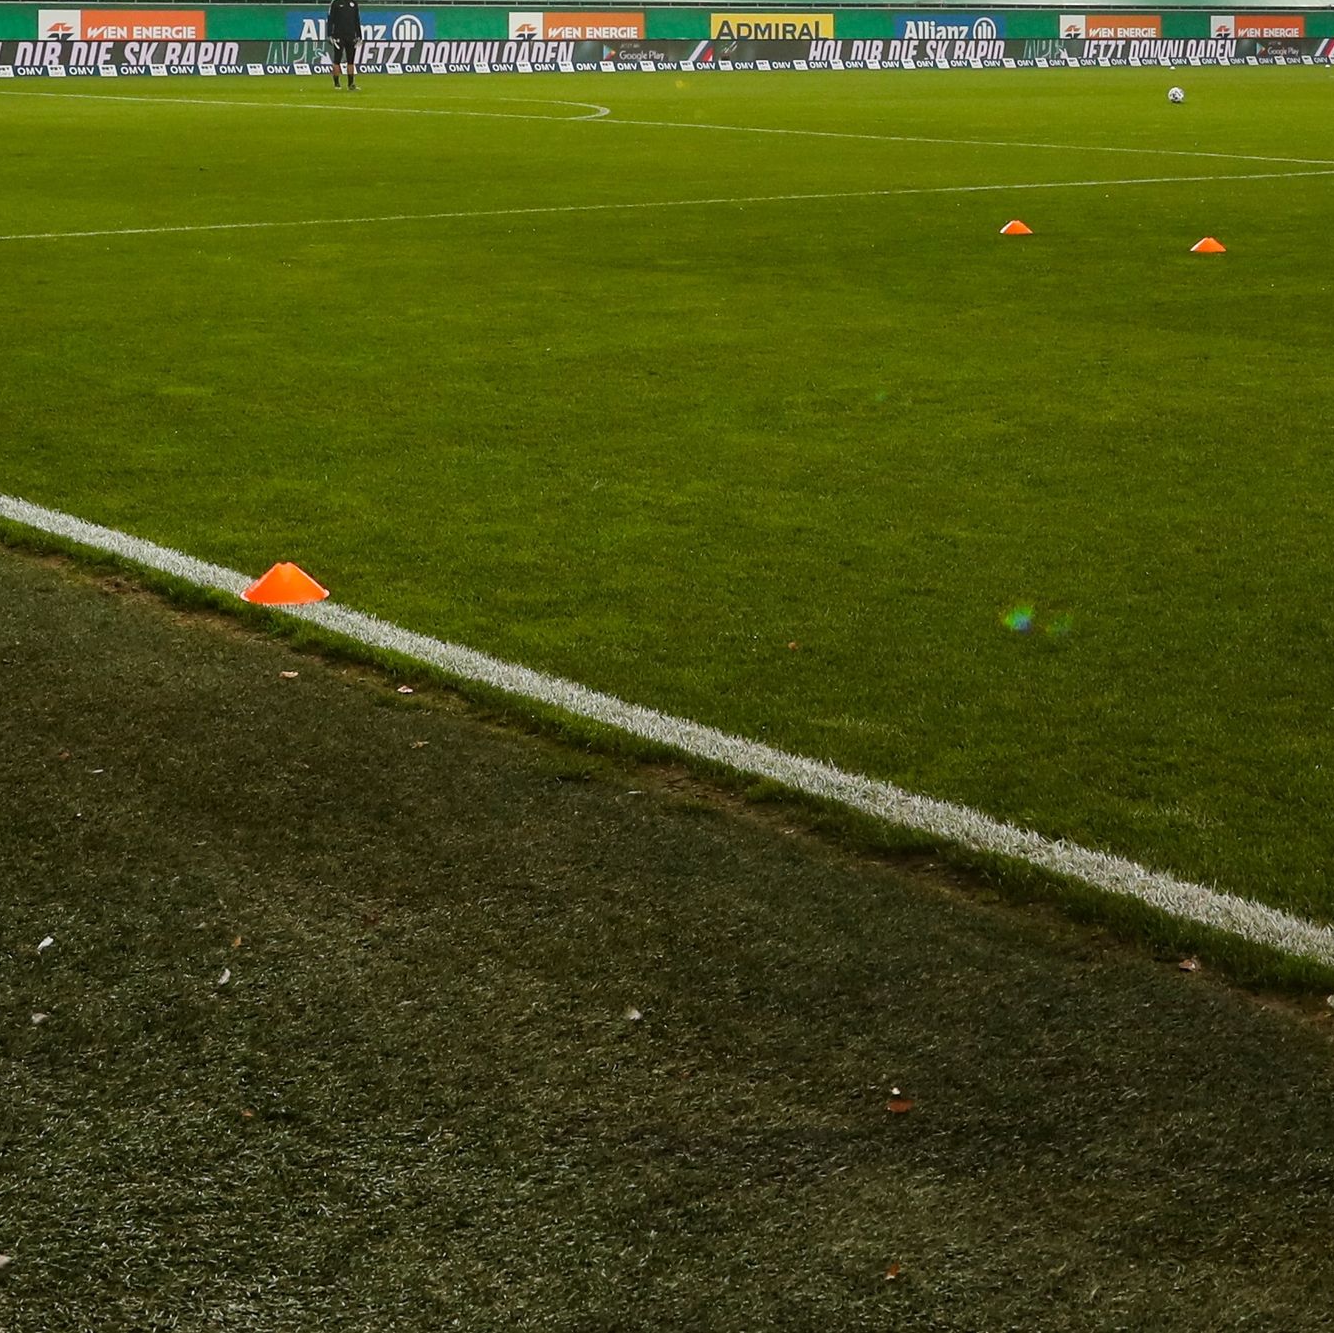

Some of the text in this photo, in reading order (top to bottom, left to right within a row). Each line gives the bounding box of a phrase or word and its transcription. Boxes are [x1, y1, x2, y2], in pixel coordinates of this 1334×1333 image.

[86, 25, 196, 39] WIEN ENERGIE
[547, 26, 638, 39] WIEN ENERGIE
[715, 19, 829, 40] ADMIRAL
[903, 20, 970, 39] Allianz
[1088, 26, 1157, 38] WIEN ENERGIE
[1237, 26, 1300, 38] WIEN ENERGIE
[619, 50, 665, 62] Google Play
